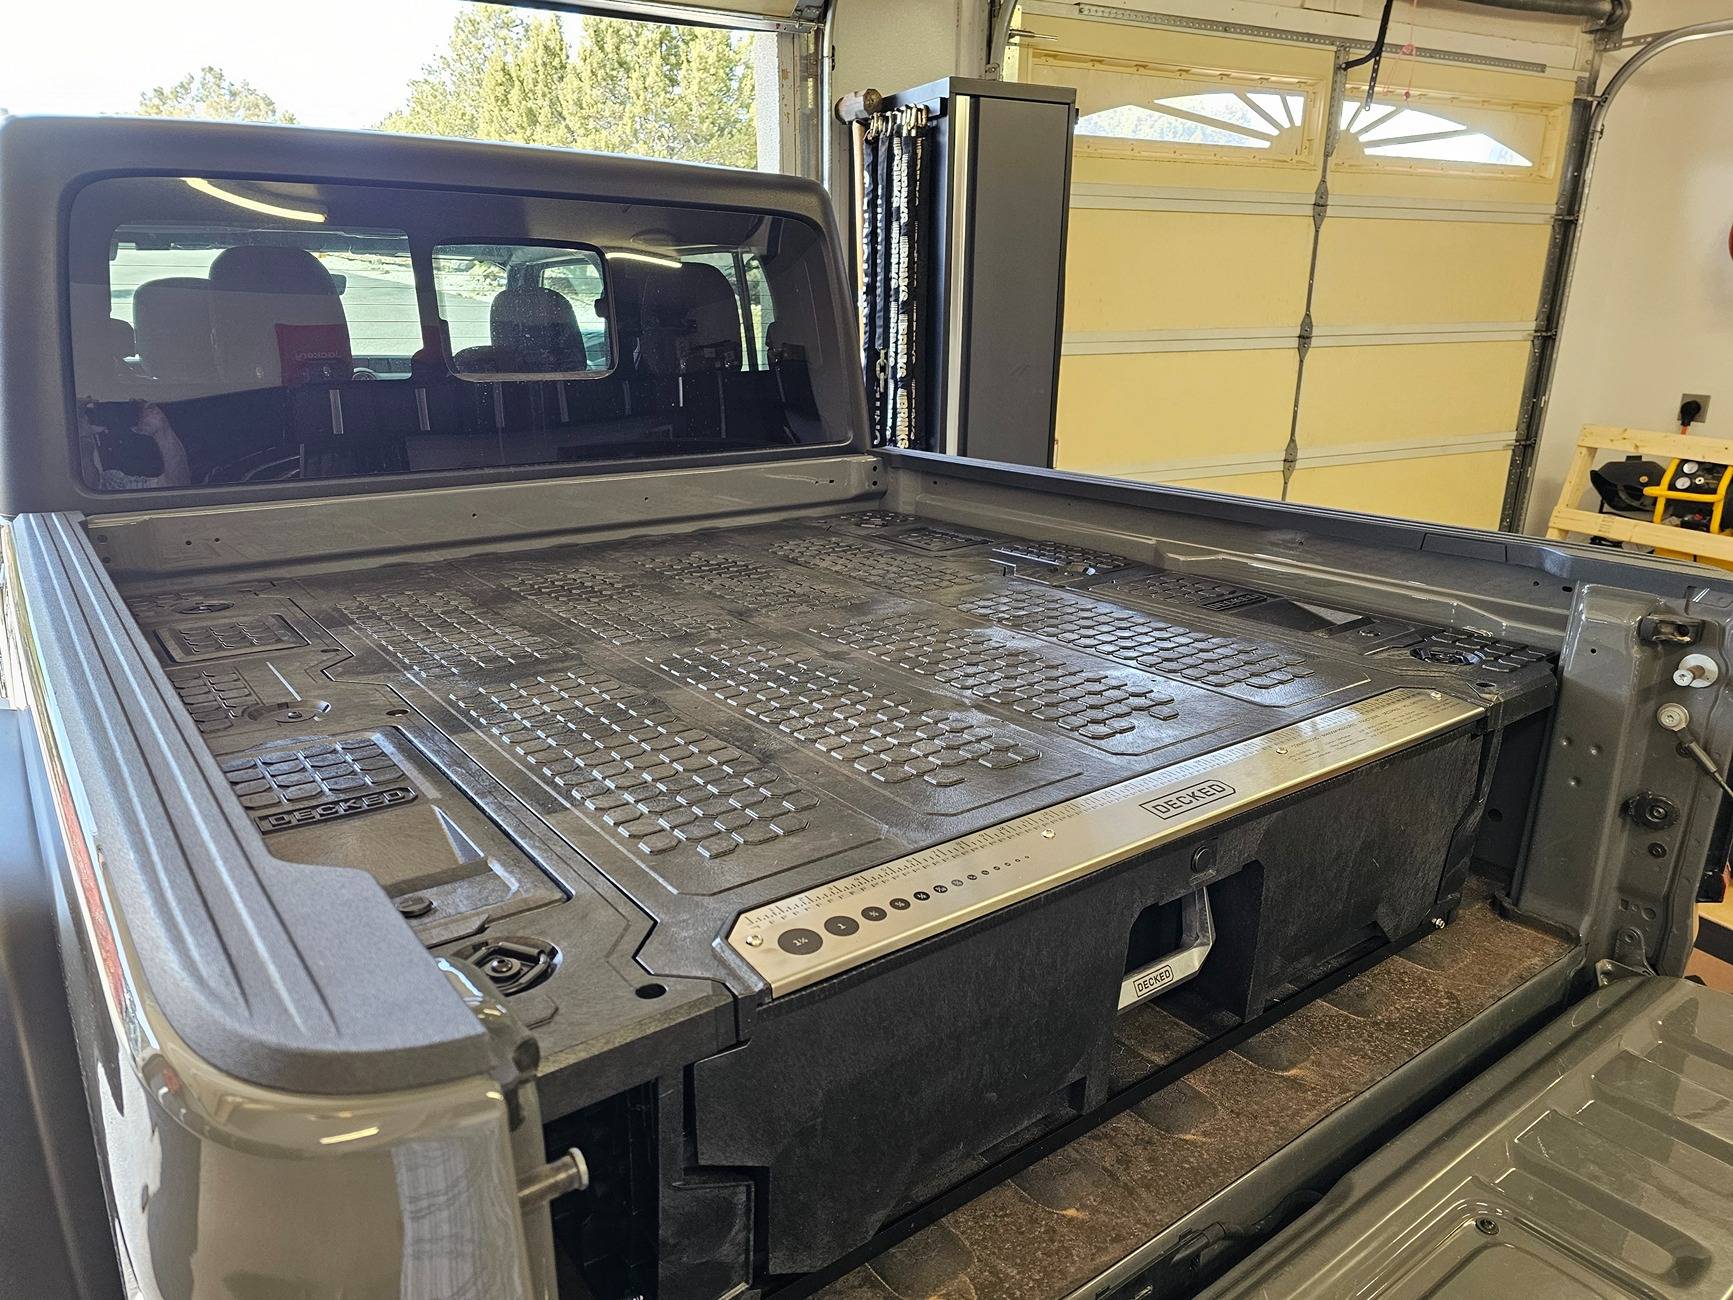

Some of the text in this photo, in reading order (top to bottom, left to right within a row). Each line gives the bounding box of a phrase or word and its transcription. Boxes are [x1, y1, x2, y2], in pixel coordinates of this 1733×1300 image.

[897, 399, 908, 449] BRINKS
[268, 789, 406, 828] DECKED
[1152, 782, 1227, 815] DECKED
[1137, 967, 1171, 993] DECKED
